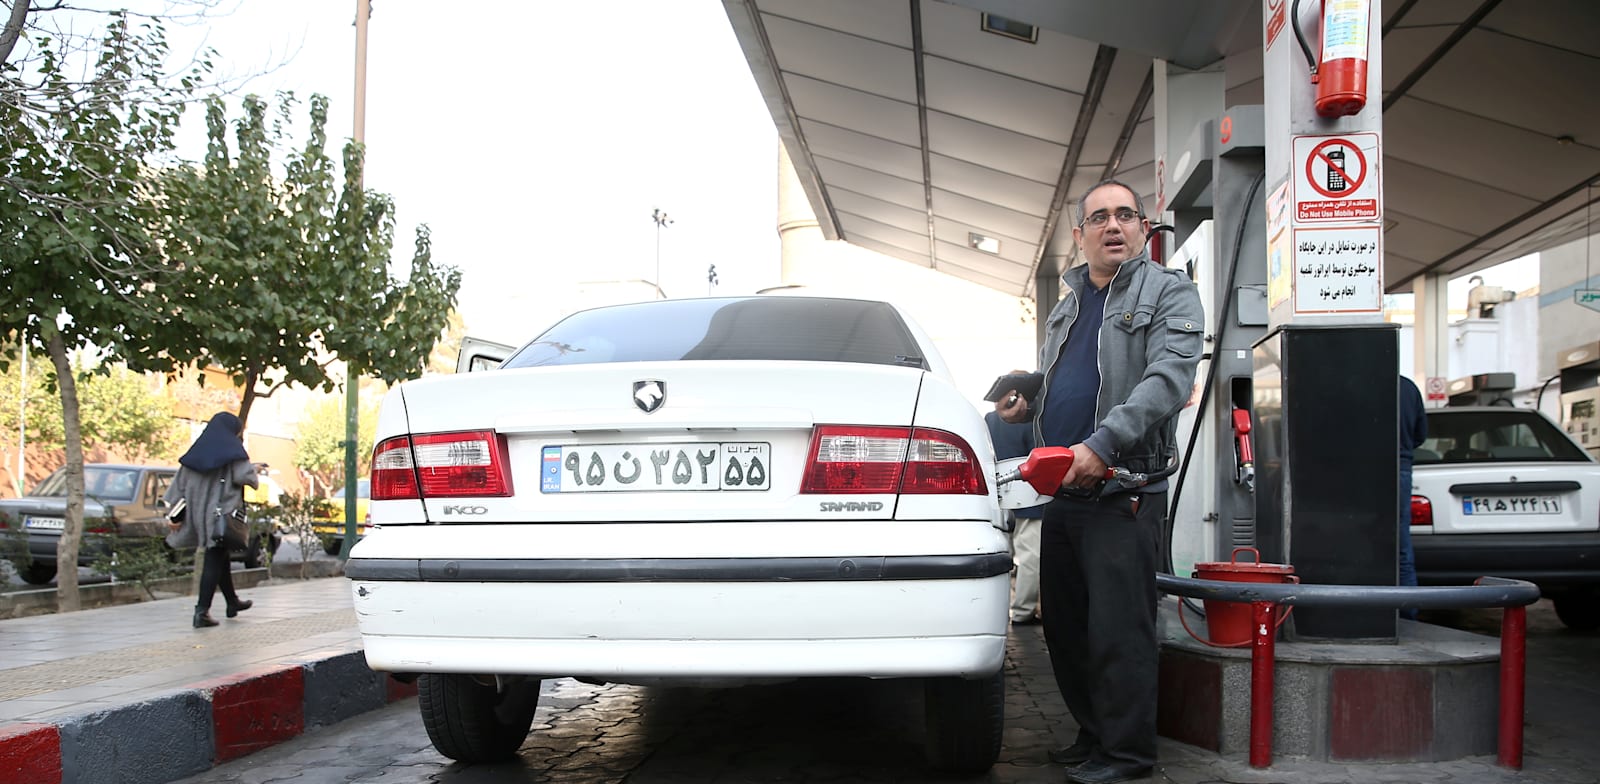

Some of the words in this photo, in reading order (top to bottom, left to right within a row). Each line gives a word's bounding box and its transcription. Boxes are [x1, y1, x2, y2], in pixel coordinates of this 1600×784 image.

[1220, 115, 1233, 145] 9
[1318, 201, 1334, 209] همراه
[1334, 200, 1347, 209] تلفن
[1334, 209, 1354, 217] Mobile
[1299, 241, 1316, 255] جایگاه
[1318, 241, 1327, 255] این
[1328, 242, 1335, 255] در
[1335, 240, 1350, 255] تمایل
[1351, 242, 1368, 255] صورت
[1368, 241, 1376, 254] در
[1332, 263, 1347, 277] توسط
[1320, 286, 1331, 300] شود
[1341, 285, 1356, 300] انجام
[724, 455, 766, 486] ۵۵
[819, 502, 884, 512] SAMAND
